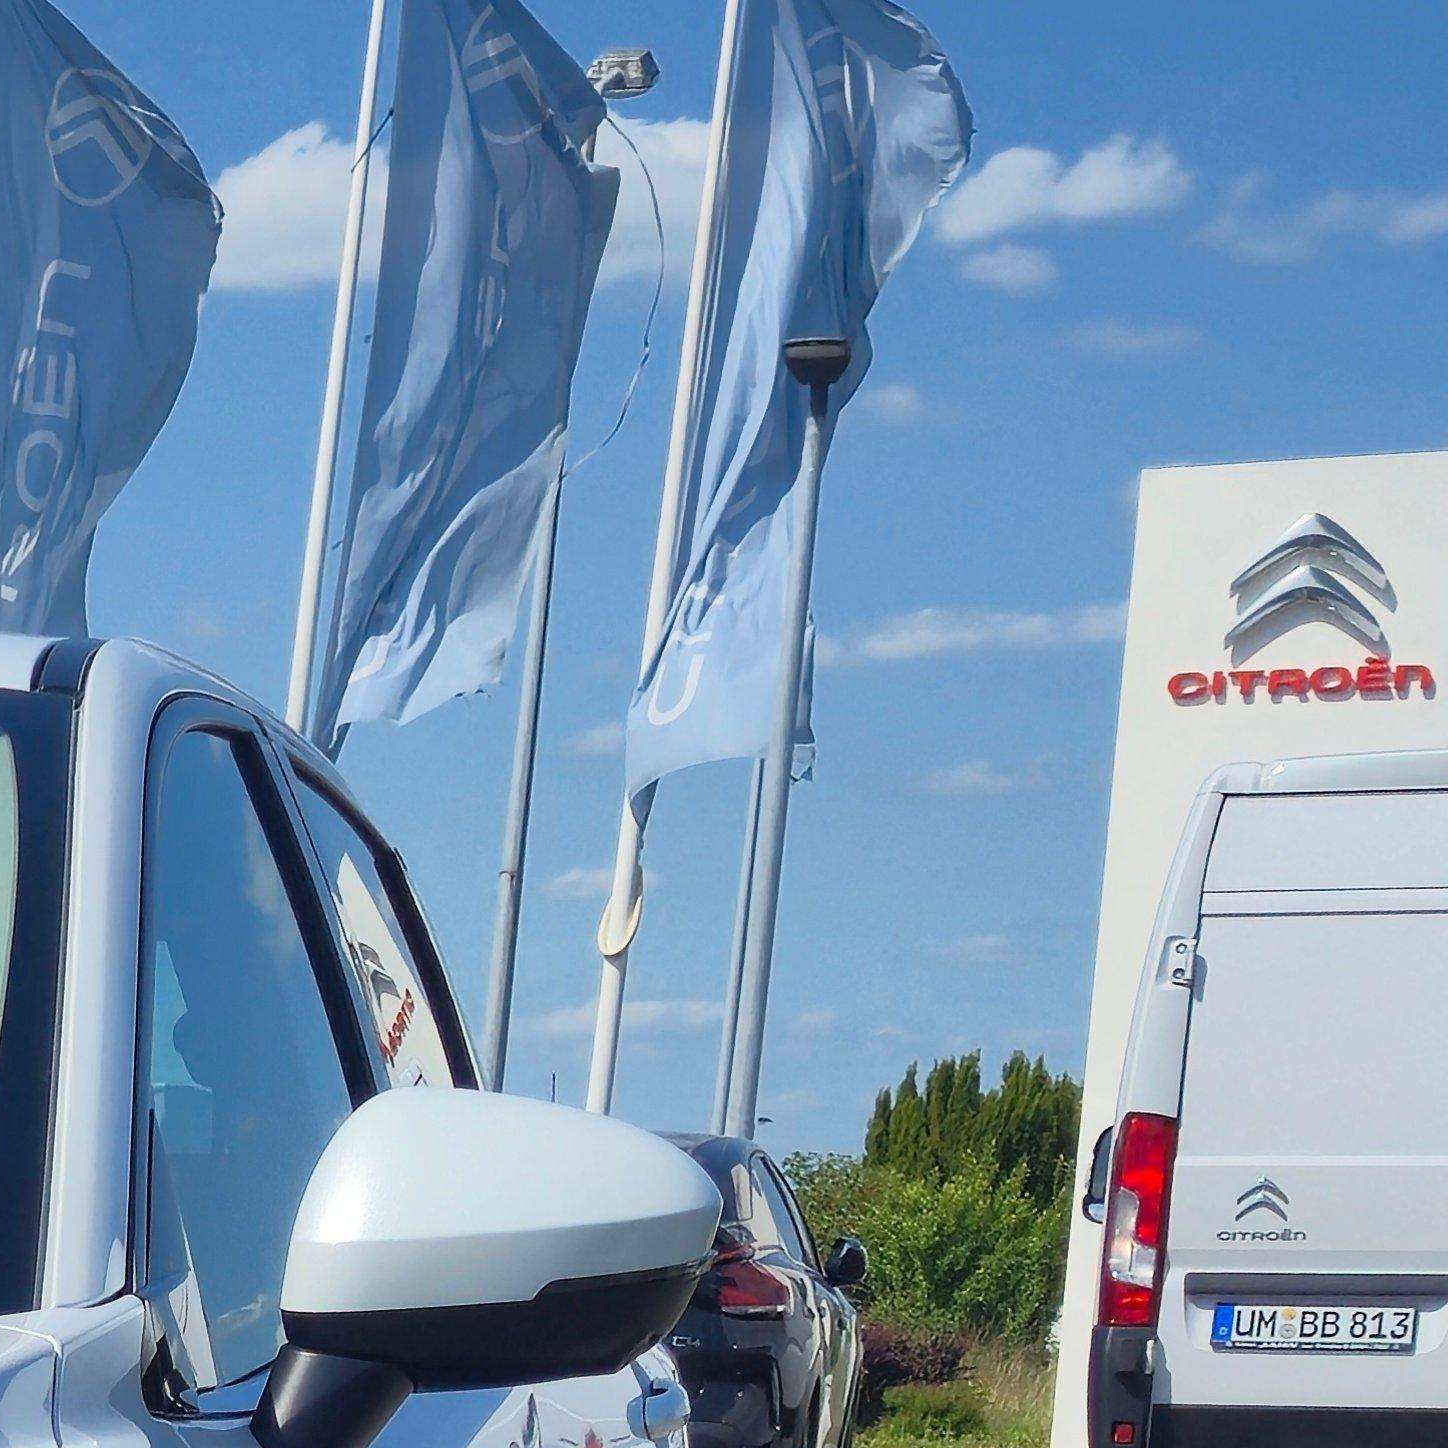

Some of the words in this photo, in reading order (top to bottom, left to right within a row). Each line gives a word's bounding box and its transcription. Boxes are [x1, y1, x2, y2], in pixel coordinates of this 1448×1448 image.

[1167, 656, 1436, 700] CITROËN
[1216, 1229, 1307, 1241] CITROËN
[1235, 1309, 1278, 1338] UM
[1299, 1310, 1341, 1338] BB
[1349, 1311, 1411, 1339] 813
